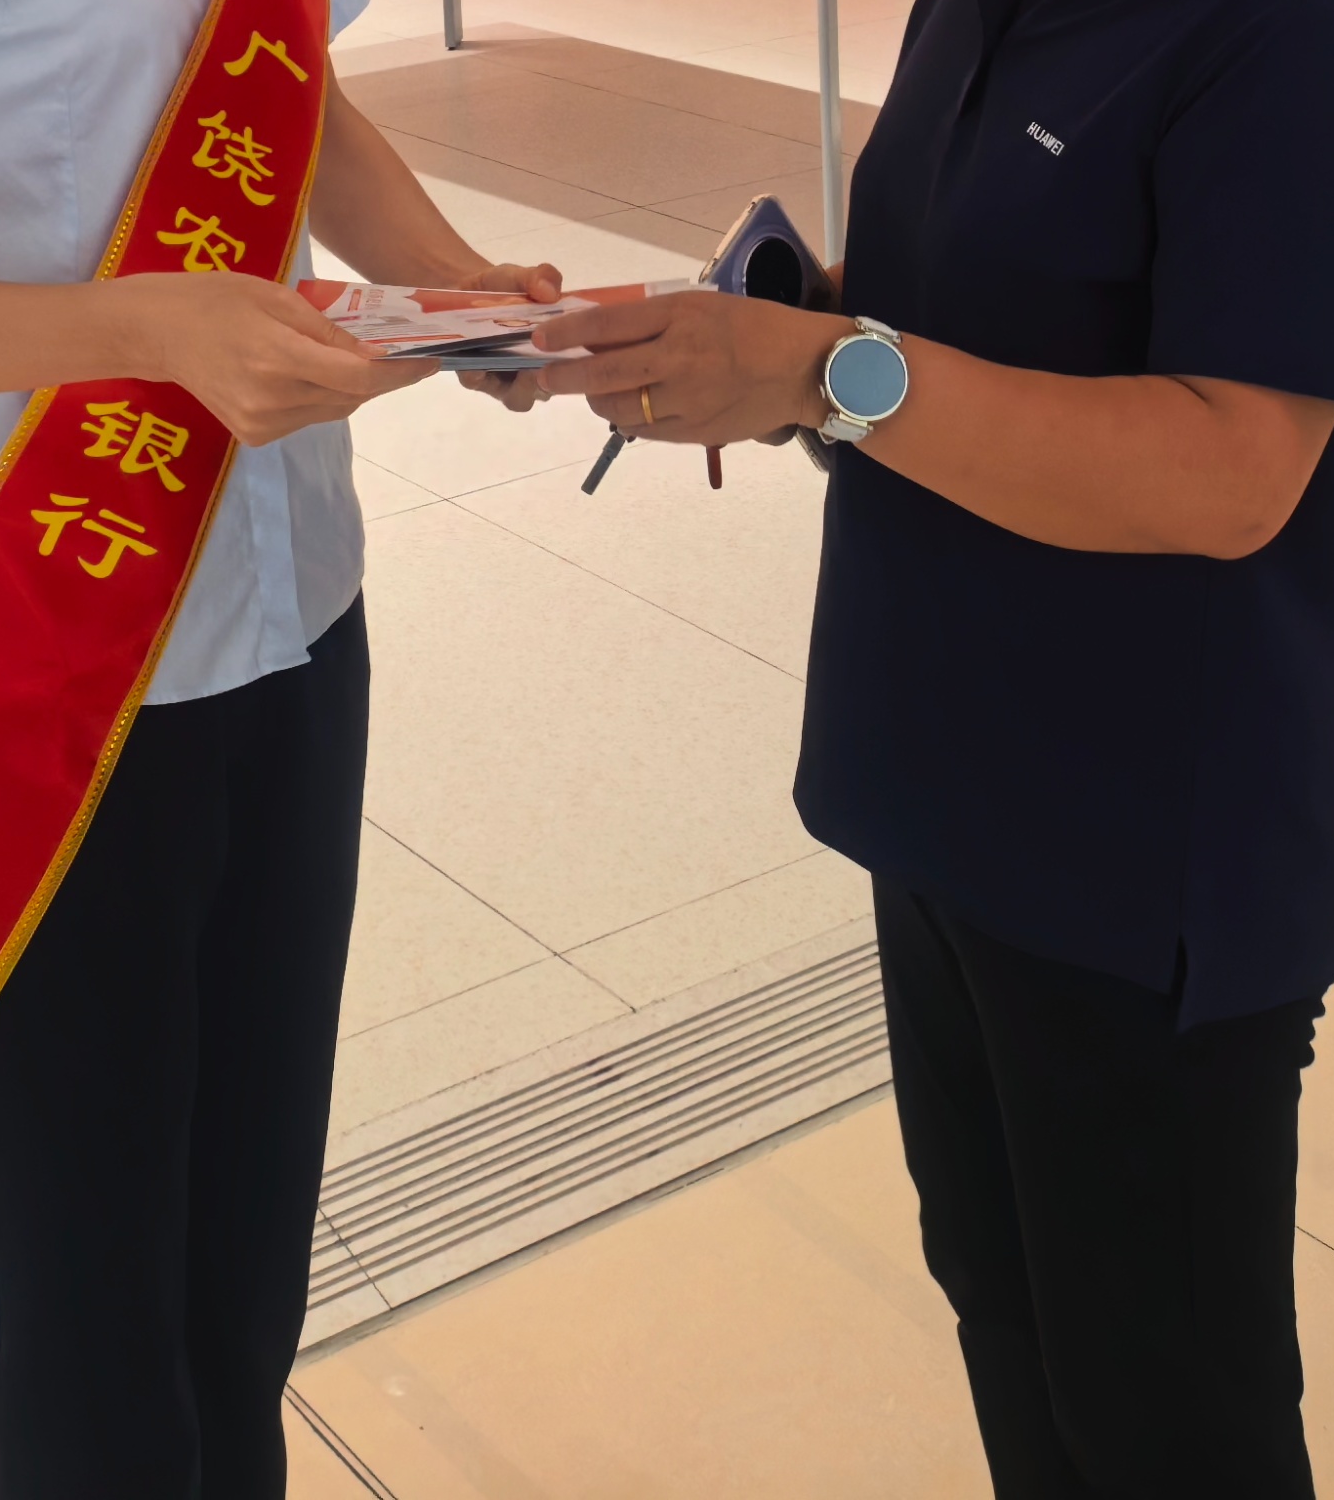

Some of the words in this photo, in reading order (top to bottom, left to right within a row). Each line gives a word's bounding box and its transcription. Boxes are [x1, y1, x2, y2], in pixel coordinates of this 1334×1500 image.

[1026, 121, 1065, 156] HUAWEI
[30, 30, 309, 578] 广饶农银行
